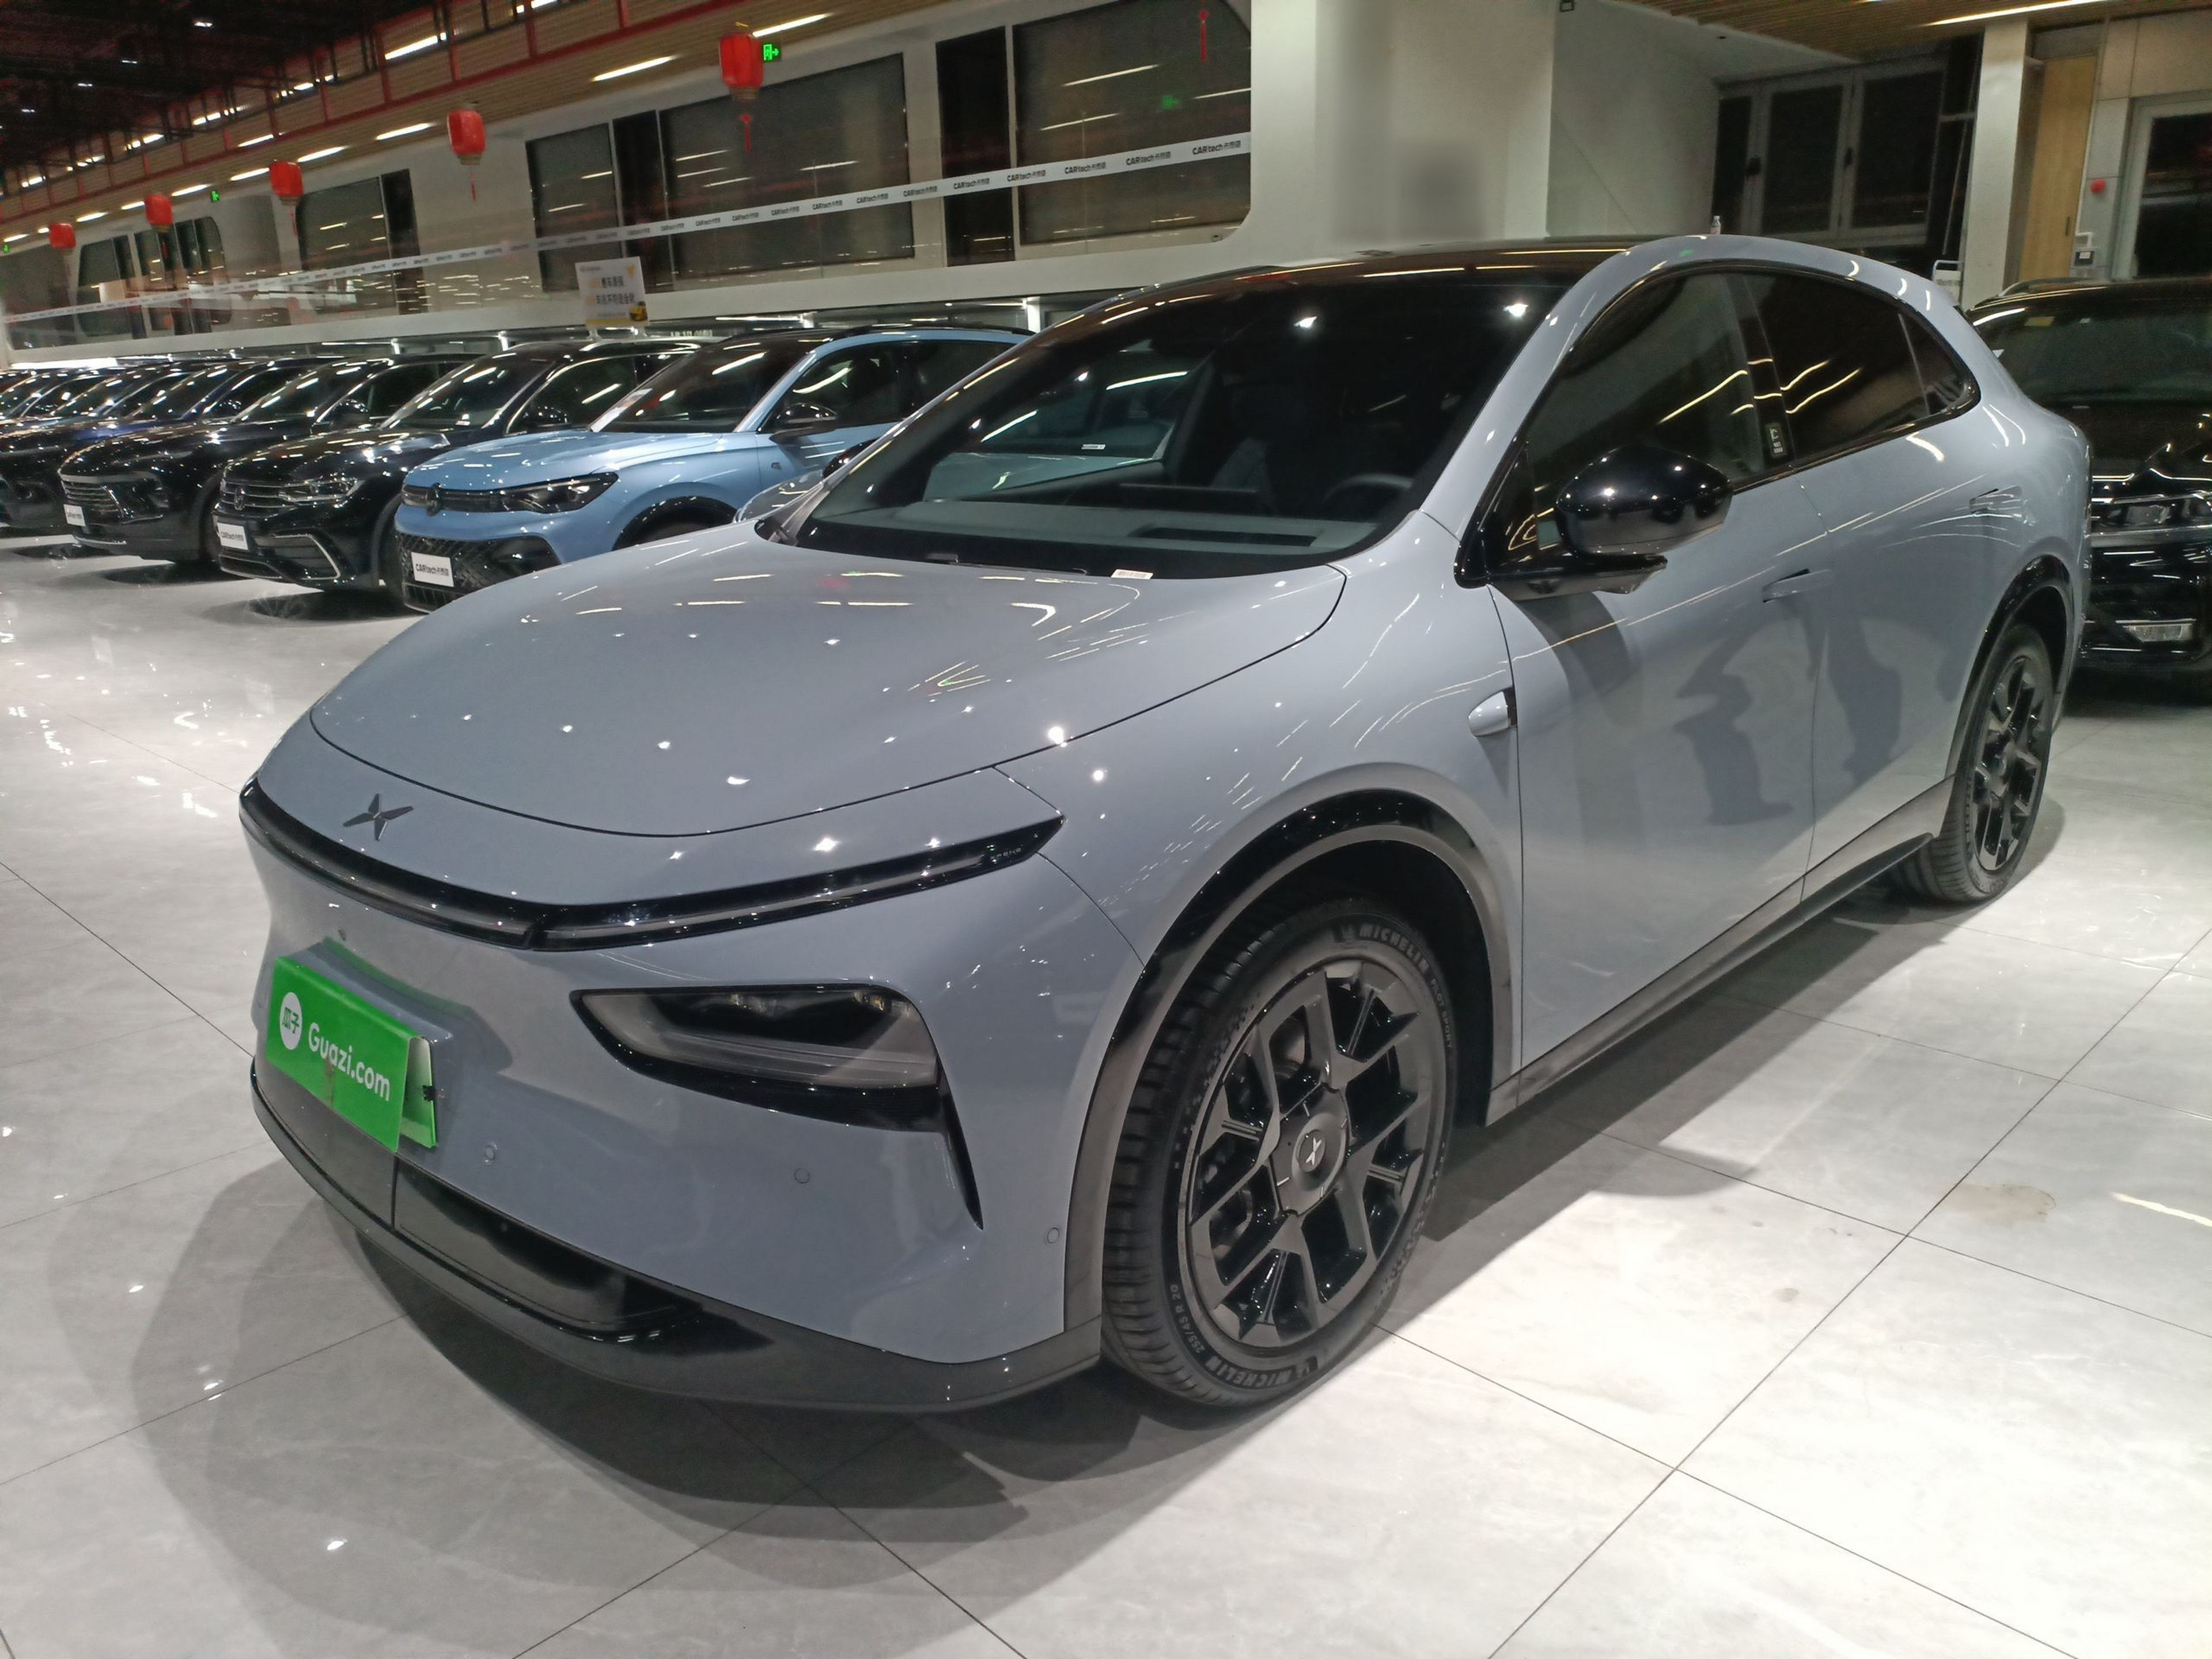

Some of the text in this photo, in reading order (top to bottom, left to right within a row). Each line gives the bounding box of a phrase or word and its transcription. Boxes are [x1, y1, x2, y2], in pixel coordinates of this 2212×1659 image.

[1359, 923, 1429, 973] MICHELIN
[282, 1006, 300, 1034] 瓜子
[308, 1022, 390, 1101] Guazi.com
[1206, 1355, 1292, 1387] MICHELIN
